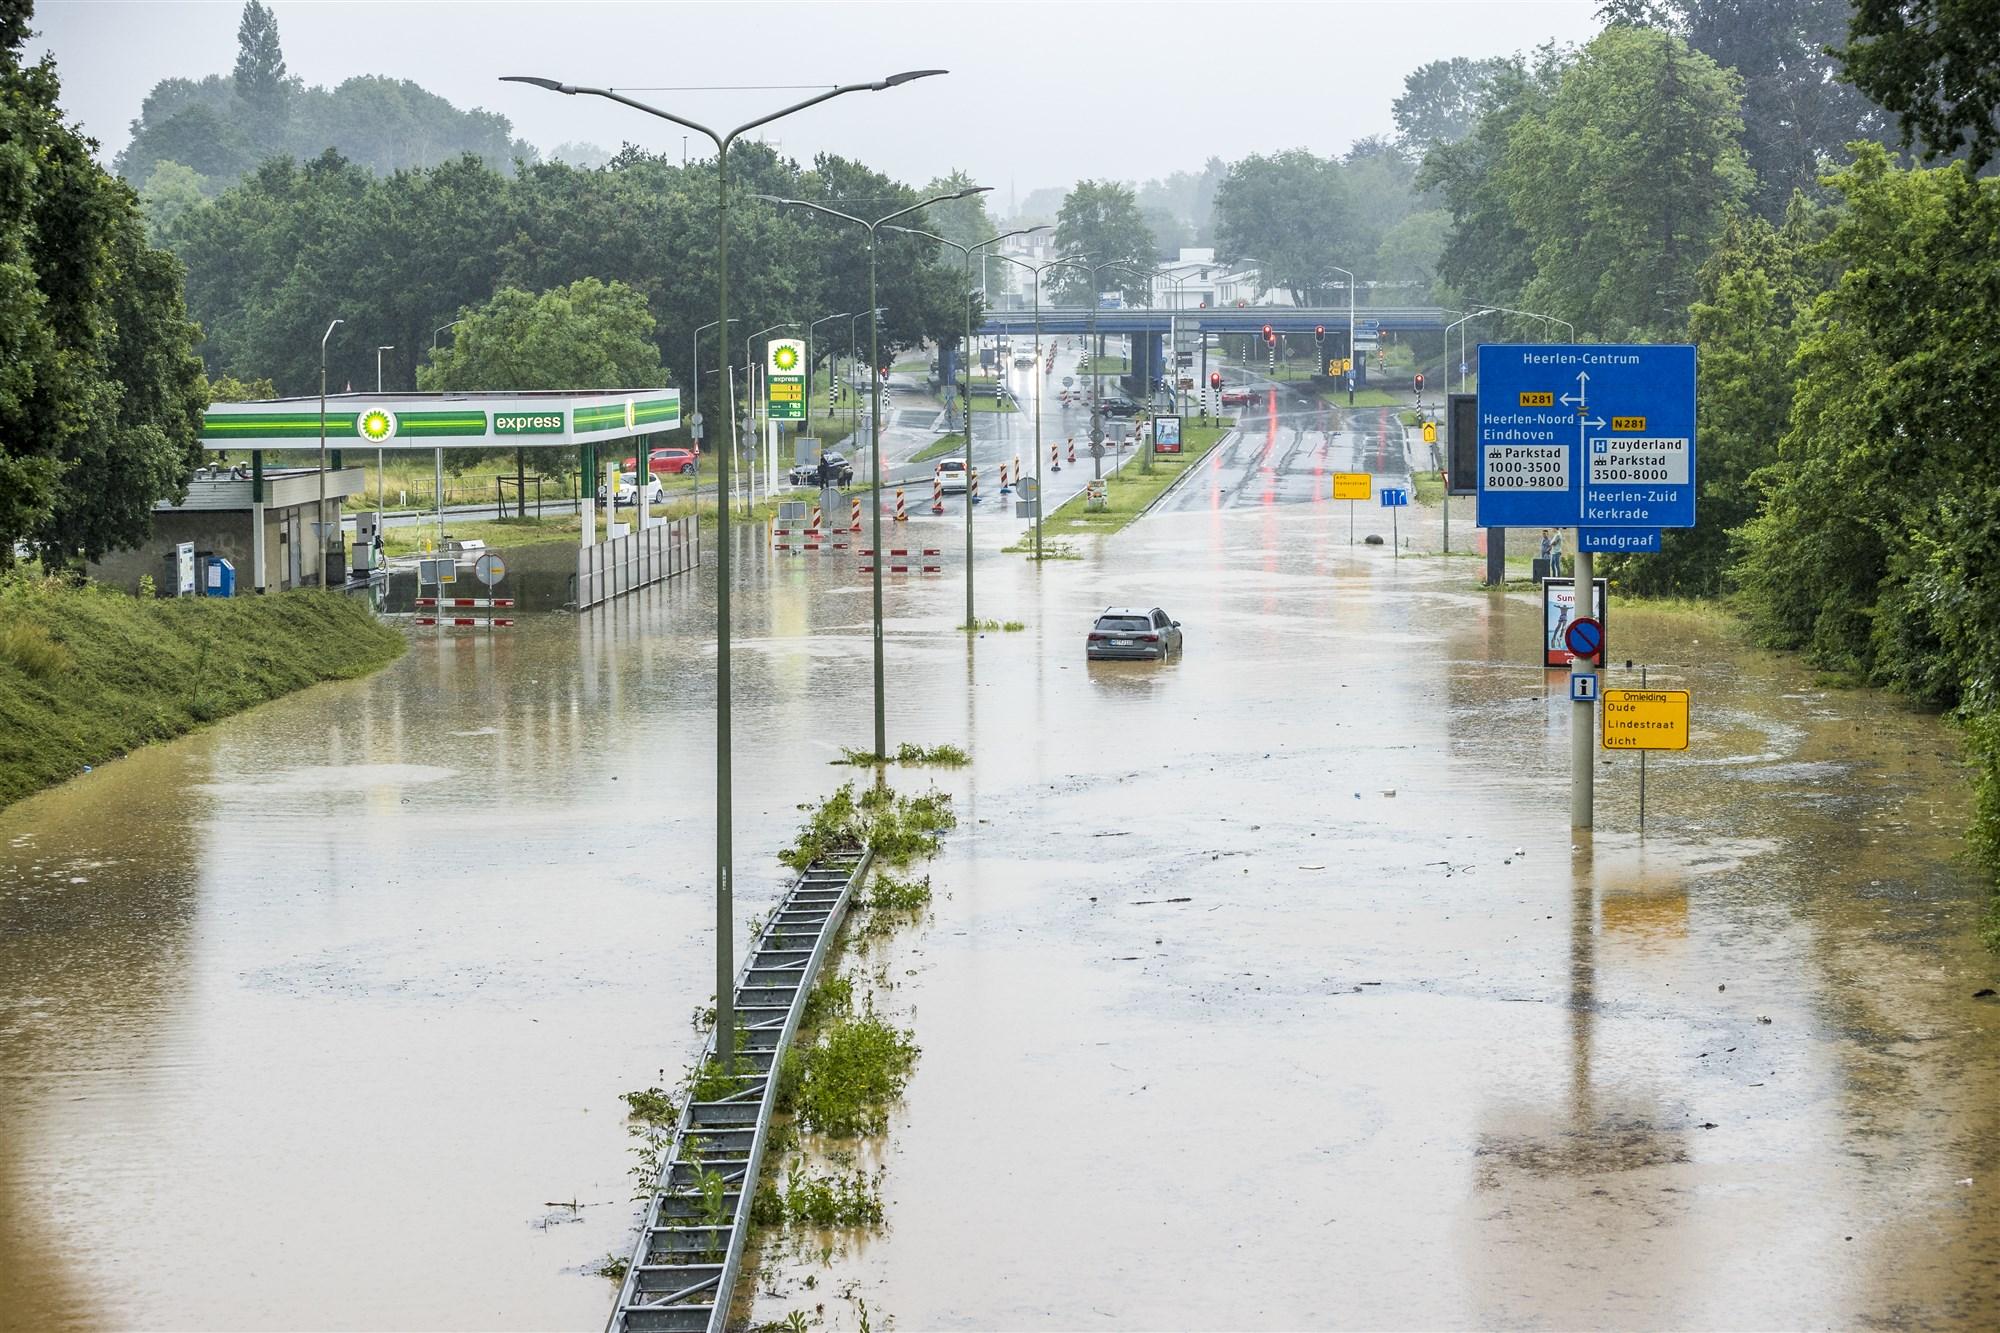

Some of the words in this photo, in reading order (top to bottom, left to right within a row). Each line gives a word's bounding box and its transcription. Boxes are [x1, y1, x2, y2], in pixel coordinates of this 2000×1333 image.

[1523, 353, 1640, 365] Heerlen-Centrum
[1522, 395, 1551, 404] N281
[496, 416, 561, 431] express
[1484, 413, 1574, 425] Heerlen-Noord
[1615, 419, 1644, 429] N281
[1484, 429, 1554, 440] Eindhoven
[1611, 439, 1682, 451] zuyderland
[1505, 447, 1561, 459] Parkstad
[1610, 455, 1666, 466] Parkstad
[1489, 462, 1561, 473] 1000-3500
[1594, 469, 1668, 480] 3500-8000
[1489, 476, 1564, 487] 8000-9800
[1588, 491, 1677, 502] Heerlen-Zuid
[1588, 508, 1649, 519] Kerkrade
[1586, 534, 1654, 547] Landgraaf
[1557, 594, 1576, 602] Sun
[1624, 693, 1667, 703] Omleiding
[1608, 703, 1636, 712] Oude
[1608, 719, 1675, 729] Lindestraat
[1607, 736, 1637, 746] dicht
